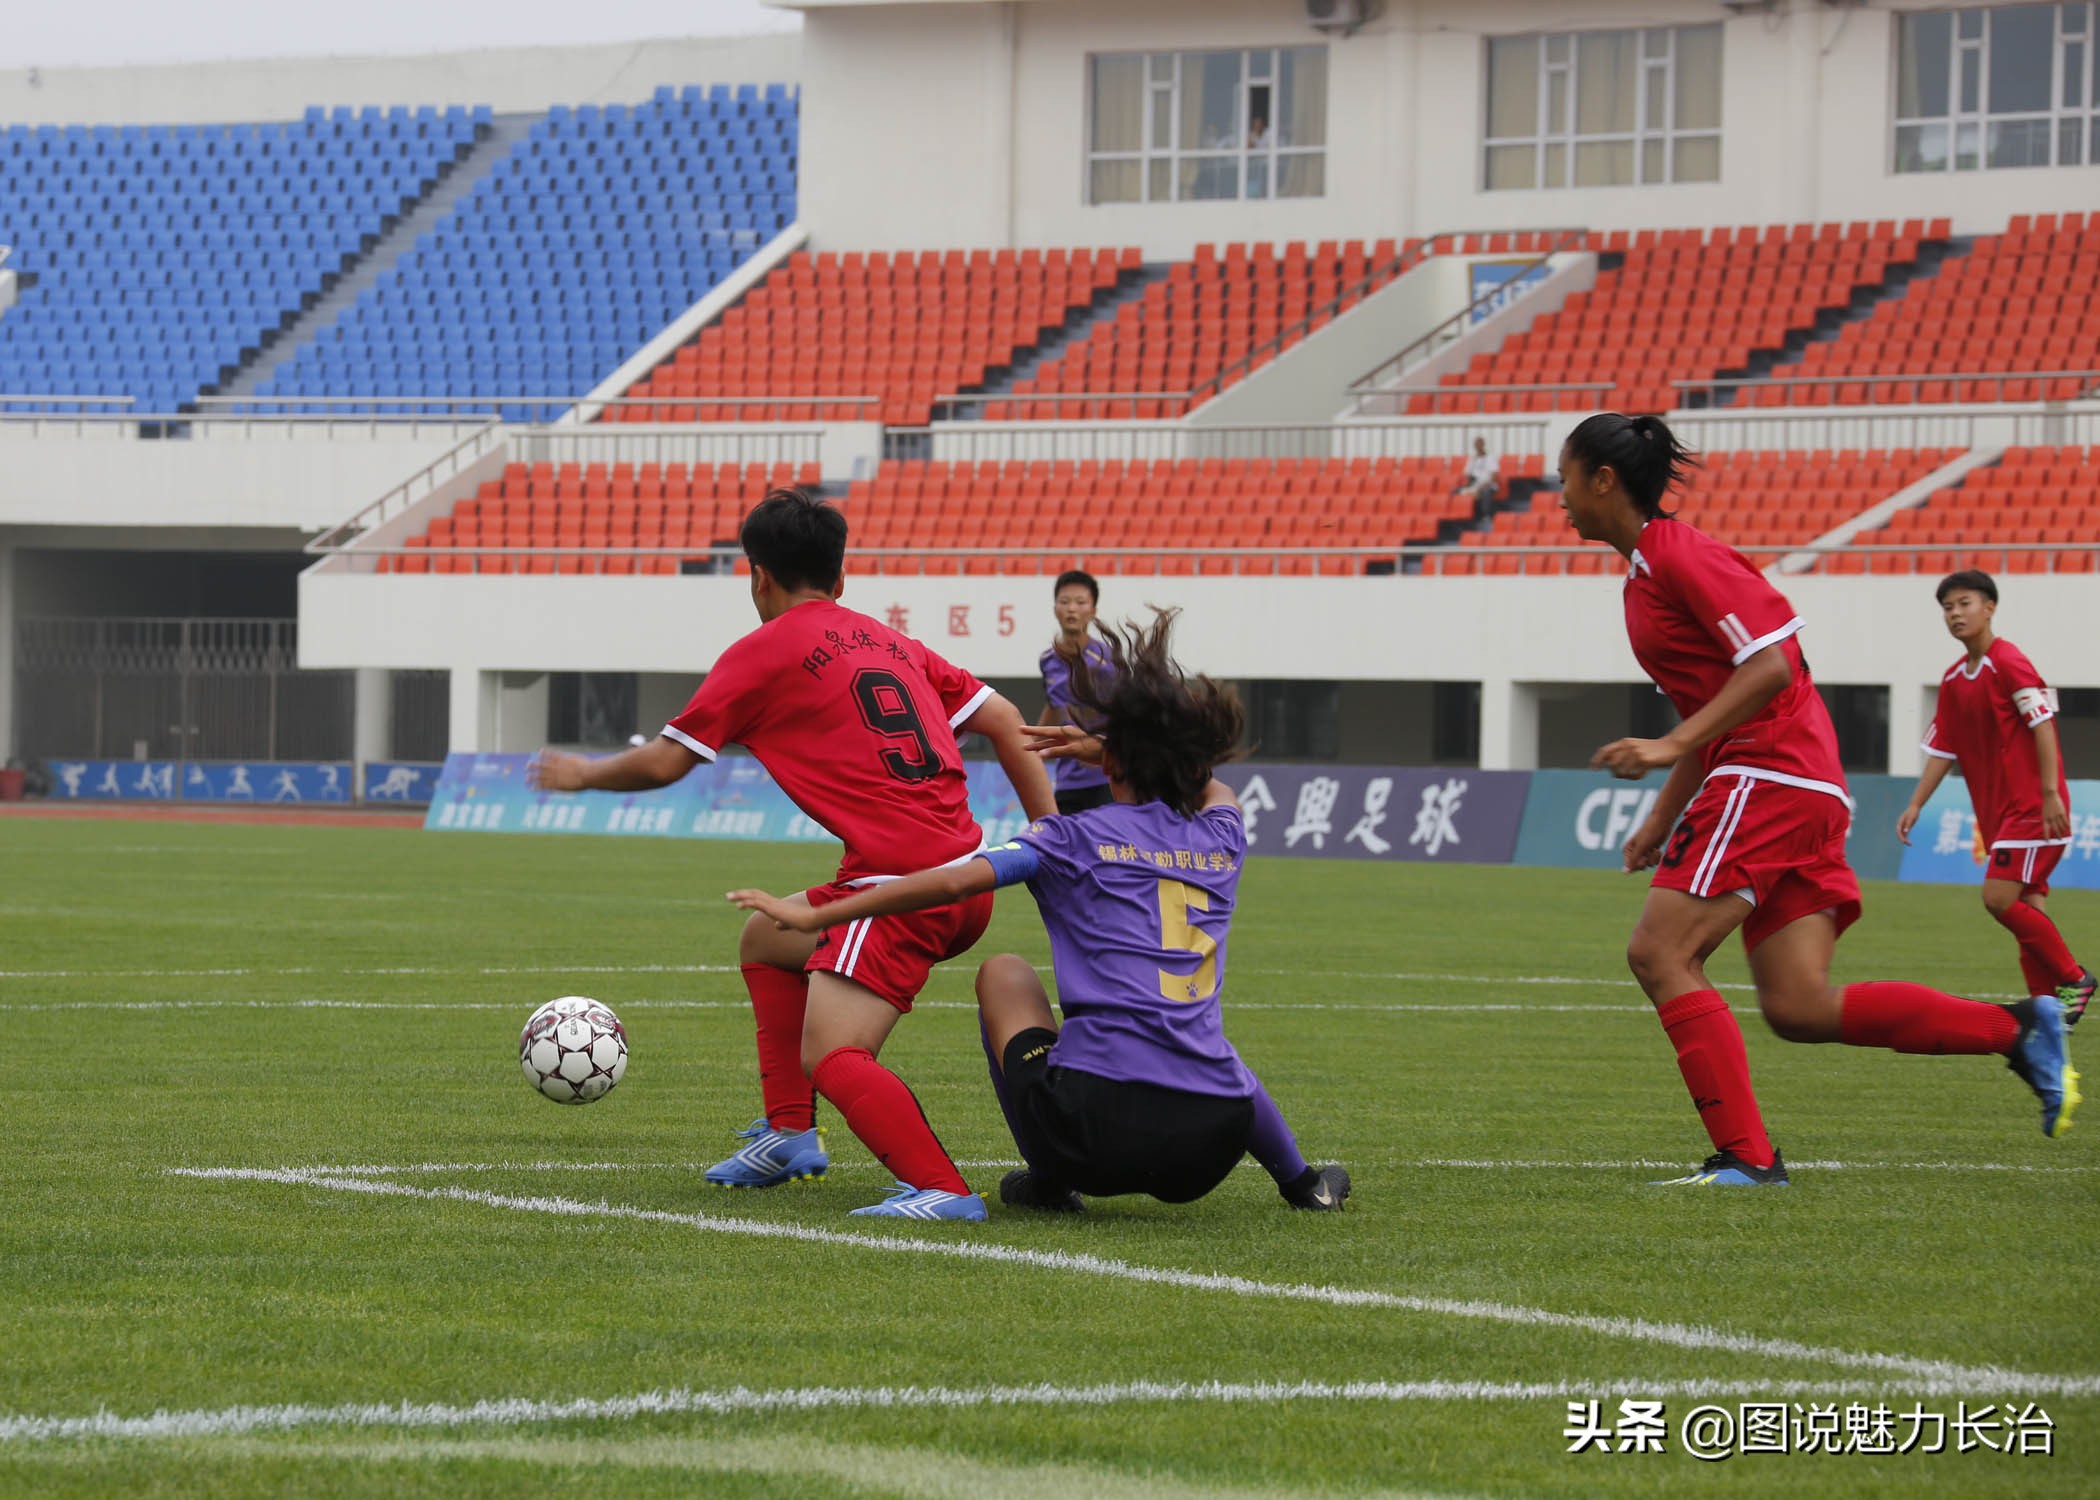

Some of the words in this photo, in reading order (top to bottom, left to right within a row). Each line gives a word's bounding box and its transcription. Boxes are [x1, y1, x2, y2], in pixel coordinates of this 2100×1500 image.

[802, 628, 918, 680] 阳泉体校
[850, 667, 947, 785] 9
[1662, 822, 1696, 869] 3
[1157, 878, 1217, 1003] 5
